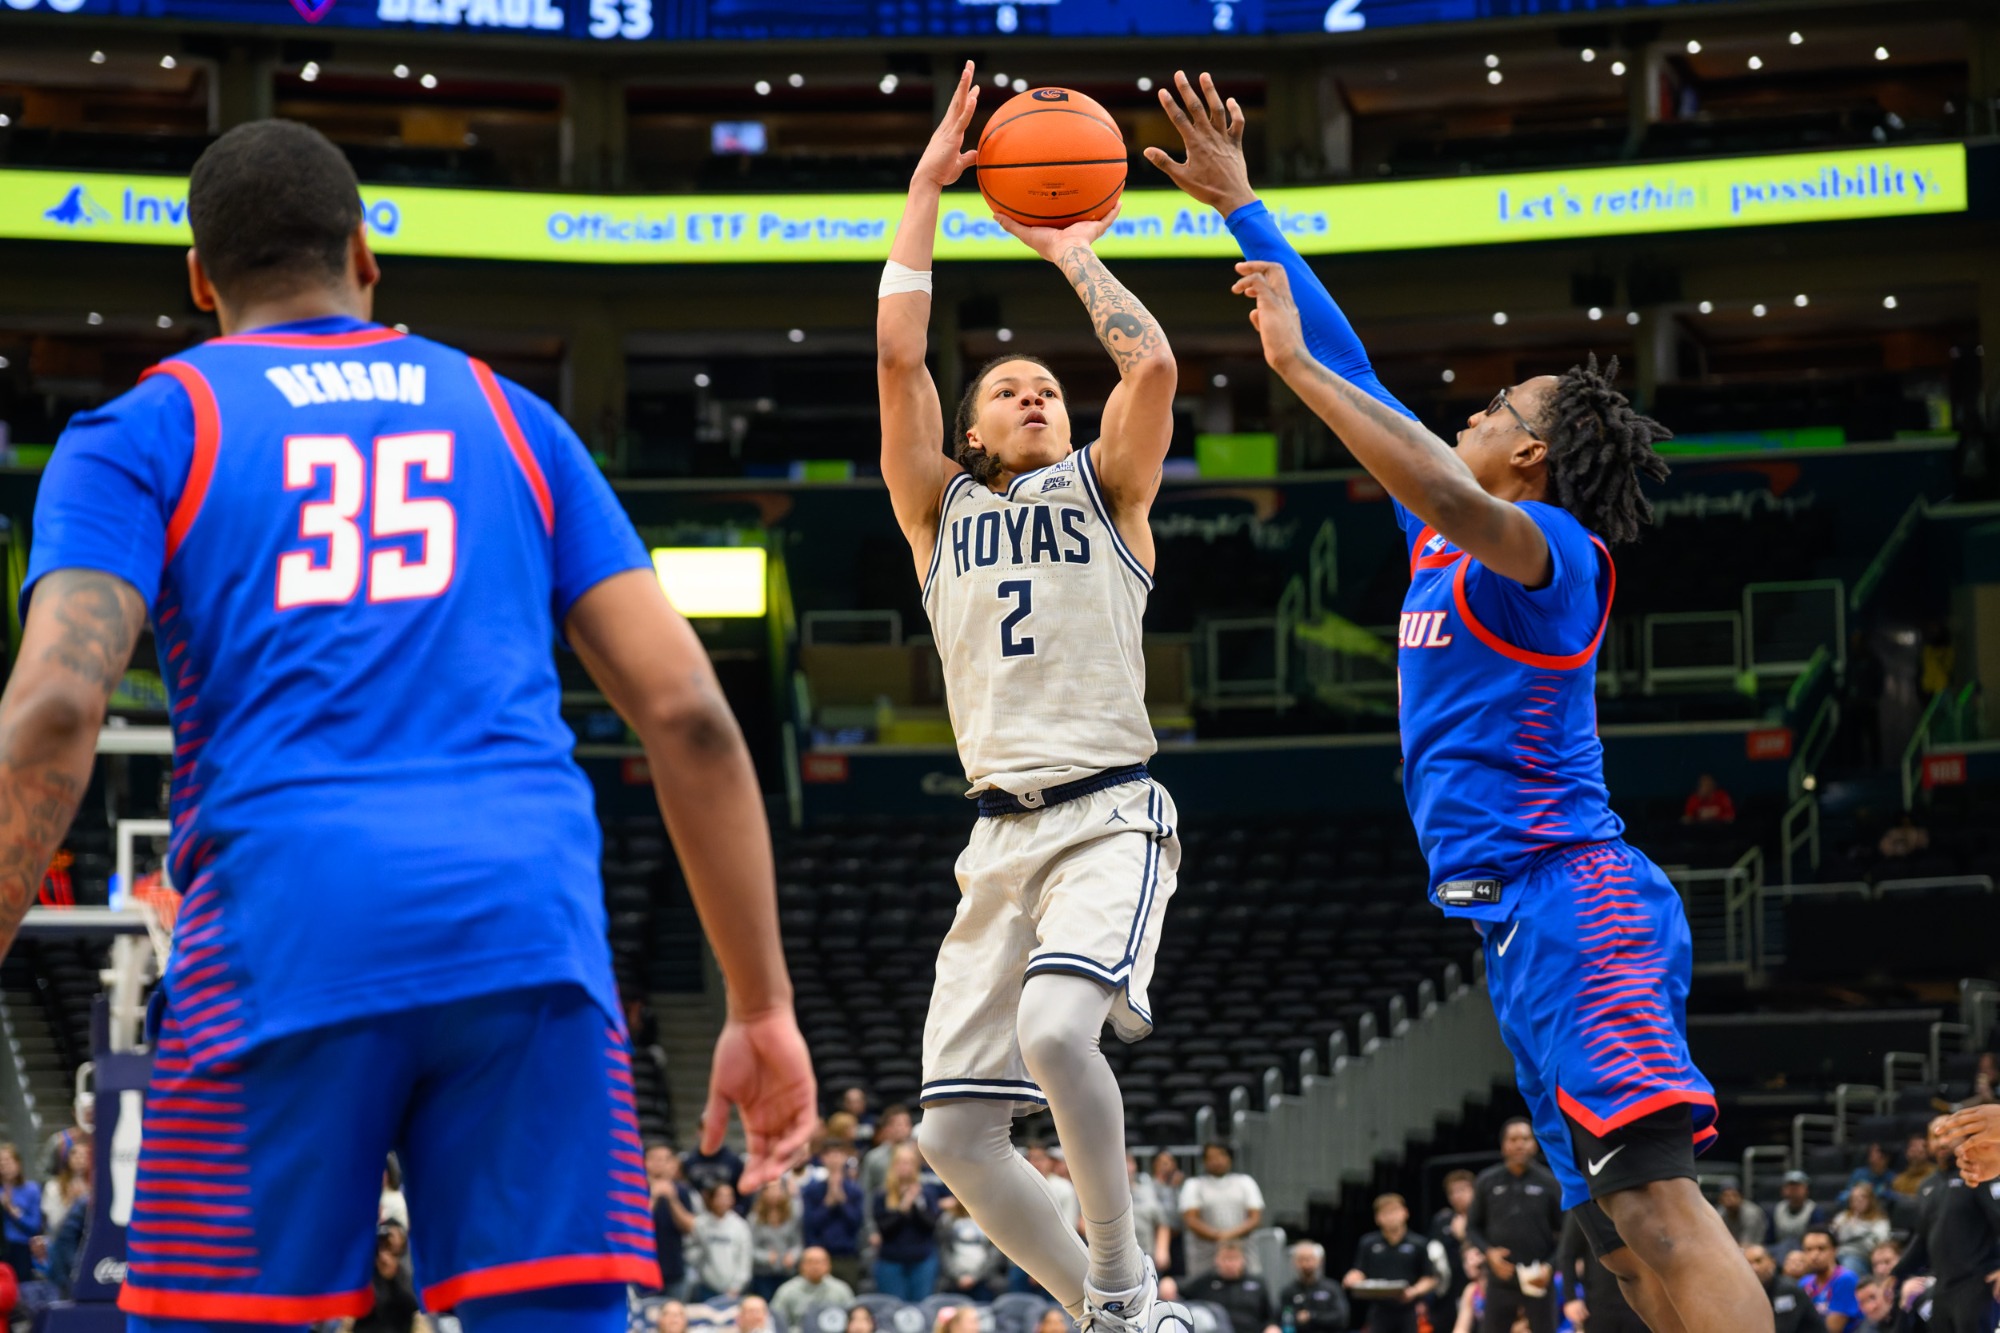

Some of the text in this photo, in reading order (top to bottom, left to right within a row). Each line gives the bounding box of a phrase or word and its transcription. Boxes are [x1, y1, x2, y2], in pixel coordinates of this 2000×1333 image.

[588, 0, 652, 40] 53
[1593, 178, 1708, 214] rethin
[547, 212, 677, 242] Official
[686, 213, 744, 242] ETF
[759, 212, 885, 241] Partner
[265, 361, 427, 408] BENSON
[1041, 480, 1073, 492] EAST
[1043, 475, 1066, 487] BIG
[273, 429, 457, 613] 35
[951, 504, 1092, 578] HOYAS
[997, 578, 1036, 659] 2
[1398, 610, 1453, 649] AUL
[1476, 884, 1491, 897] 44
